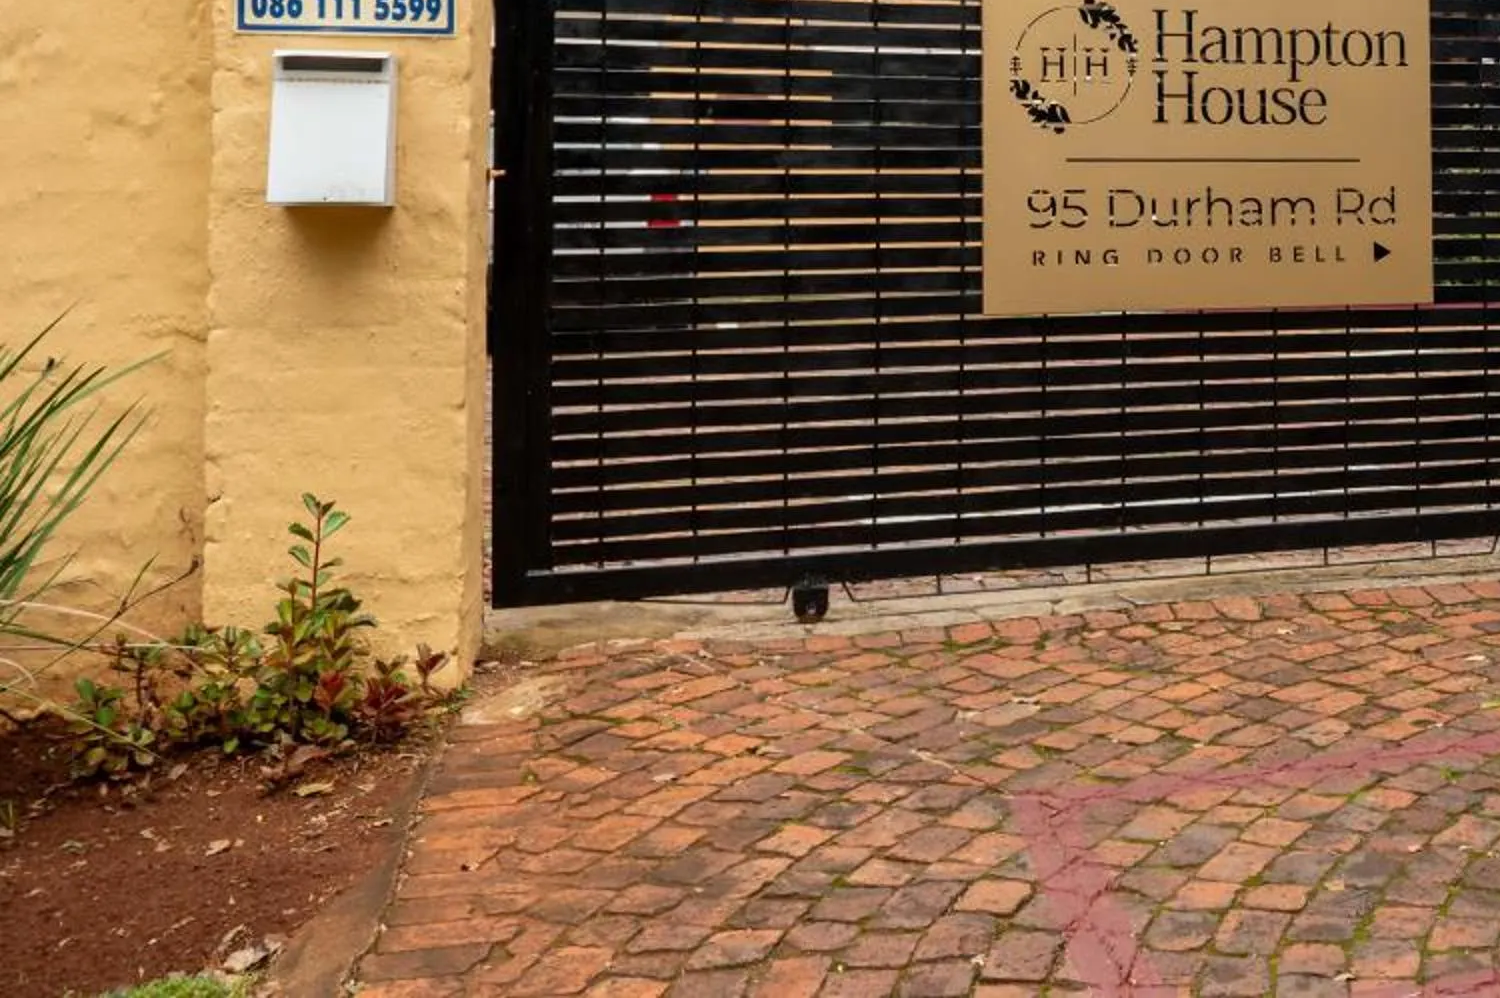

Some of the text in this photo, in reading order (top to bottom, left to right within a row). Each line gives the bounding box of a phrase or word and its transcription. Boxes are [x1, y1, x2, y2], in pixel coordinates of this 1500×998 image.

[1151, 9, 1409, 82] Hampton
[1151, 69, 1328, 125] House
[1026, 185, 1397, 229] 95 Durham Rd
[1032, 245, 1346, 267] RING DOOR BELL
